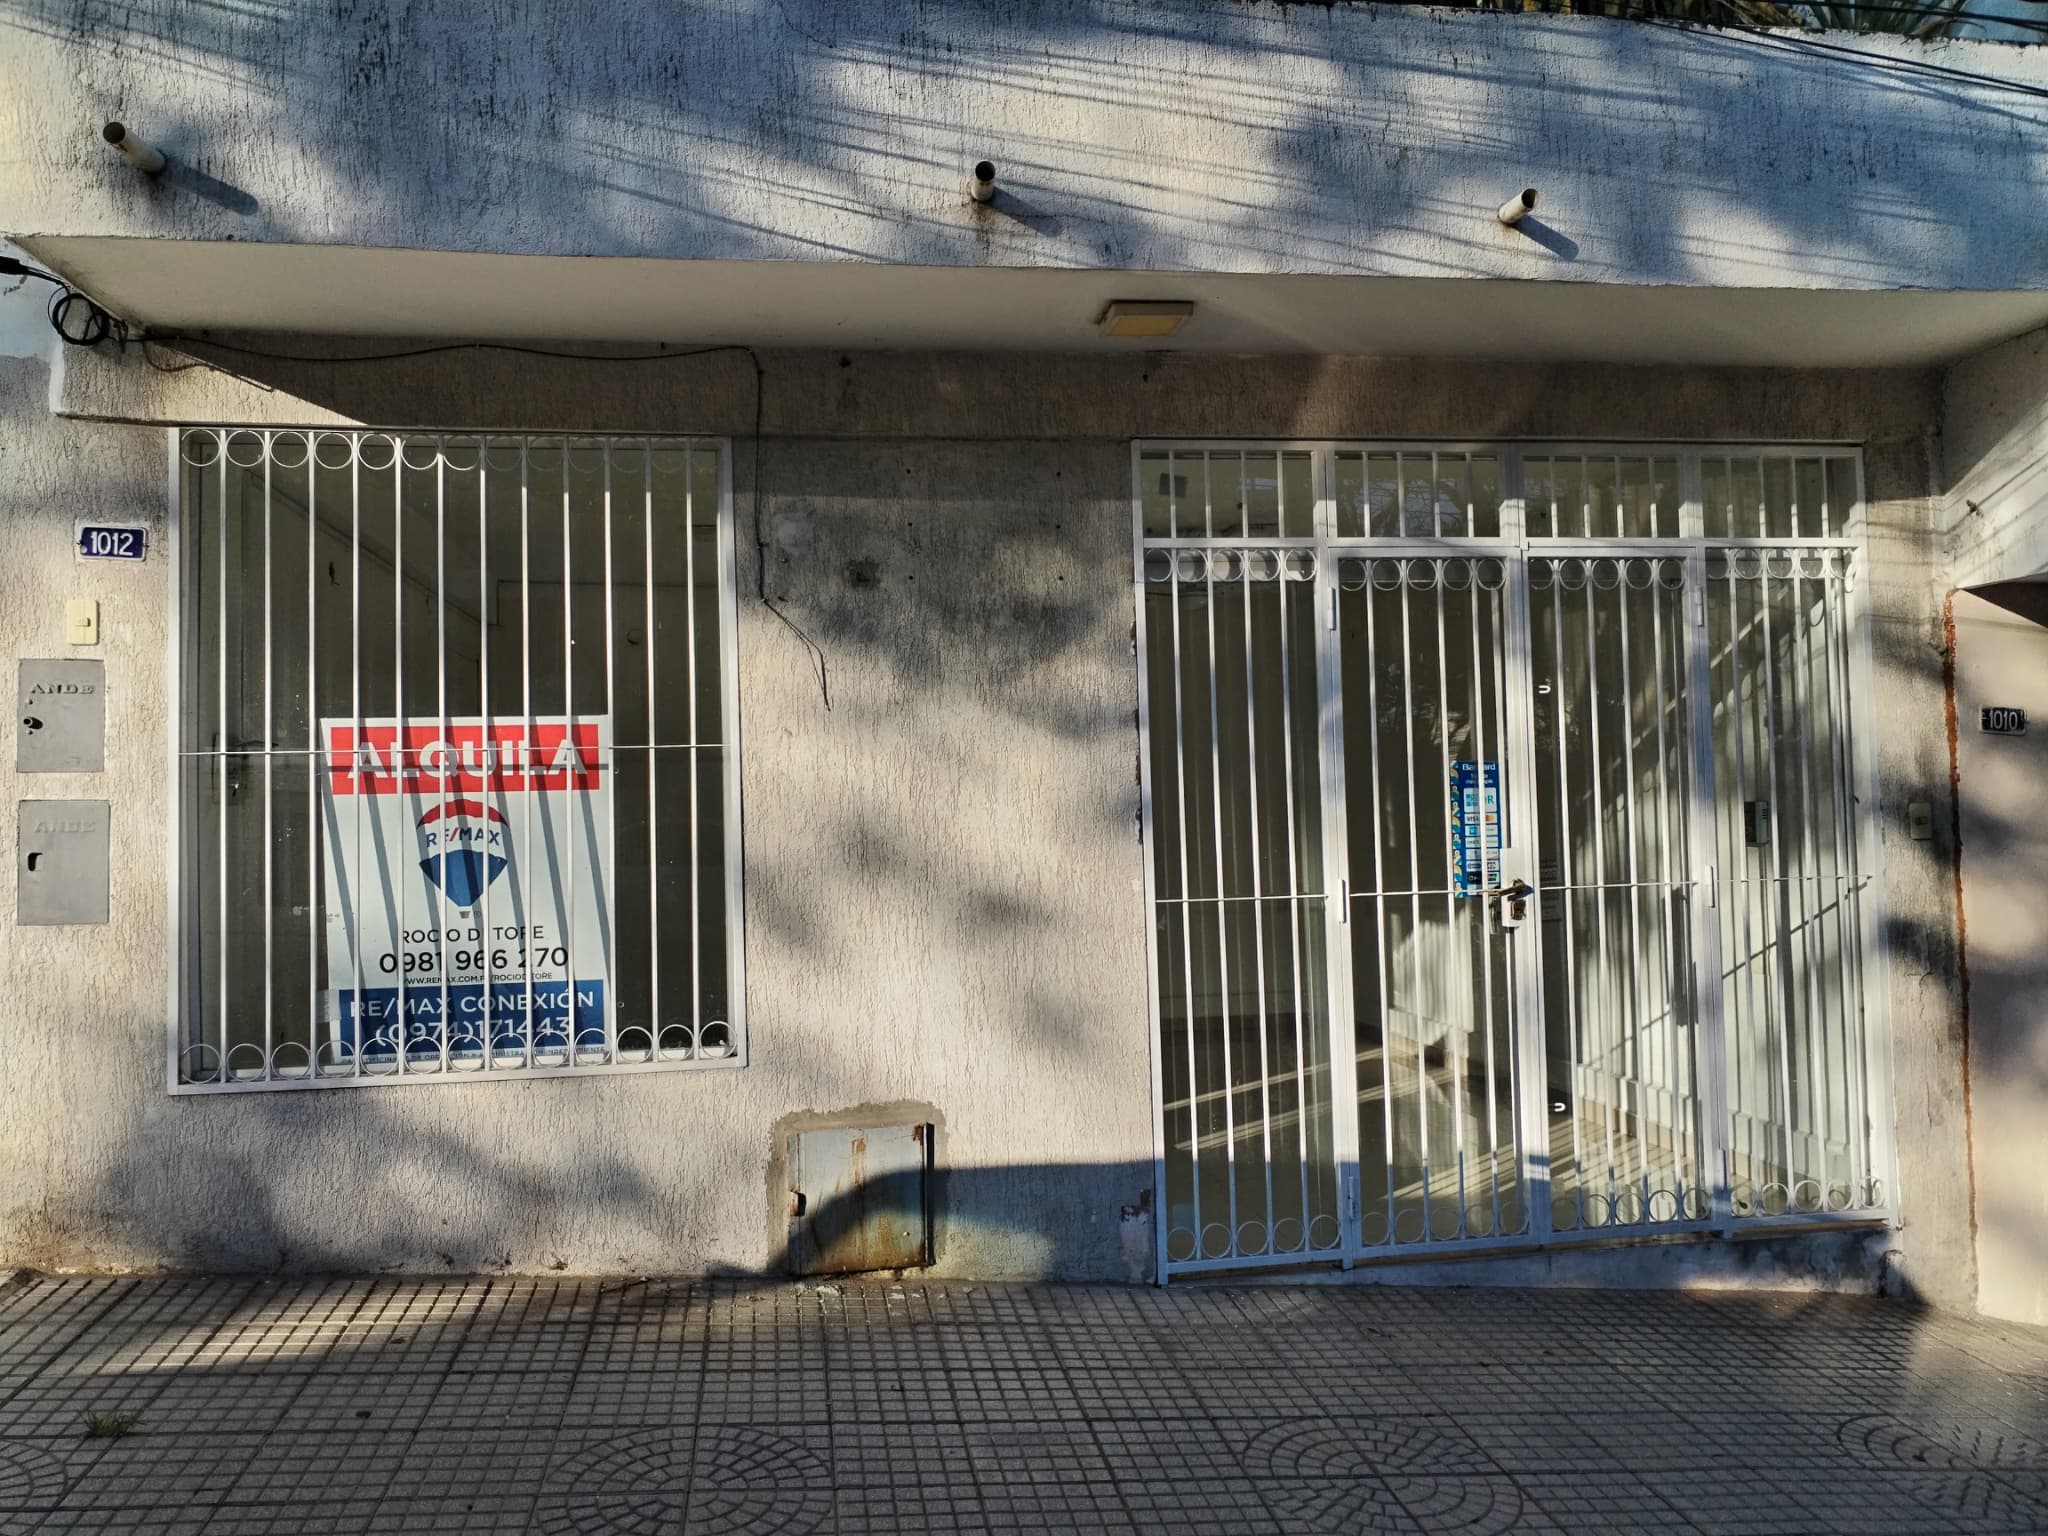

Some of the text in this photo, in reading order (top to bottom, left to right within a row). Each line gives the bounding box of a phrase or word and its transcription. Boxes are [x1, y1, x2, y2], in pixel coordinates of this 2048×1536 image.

[90, 531, 134, 556] 1012
[31, 684, 95, 695] ANDE
[1989, 710, 2018, 730] 1010
[347, 739, 588, 779] ALQUILA
[426, 827, 501, 847] RE/MAX
[402, 928, 461, 944] ROCO
[379, 947, 568, 974] 0981 966 270
[350, 988, 594, 1019] RE/MAX CONEXIÓN
